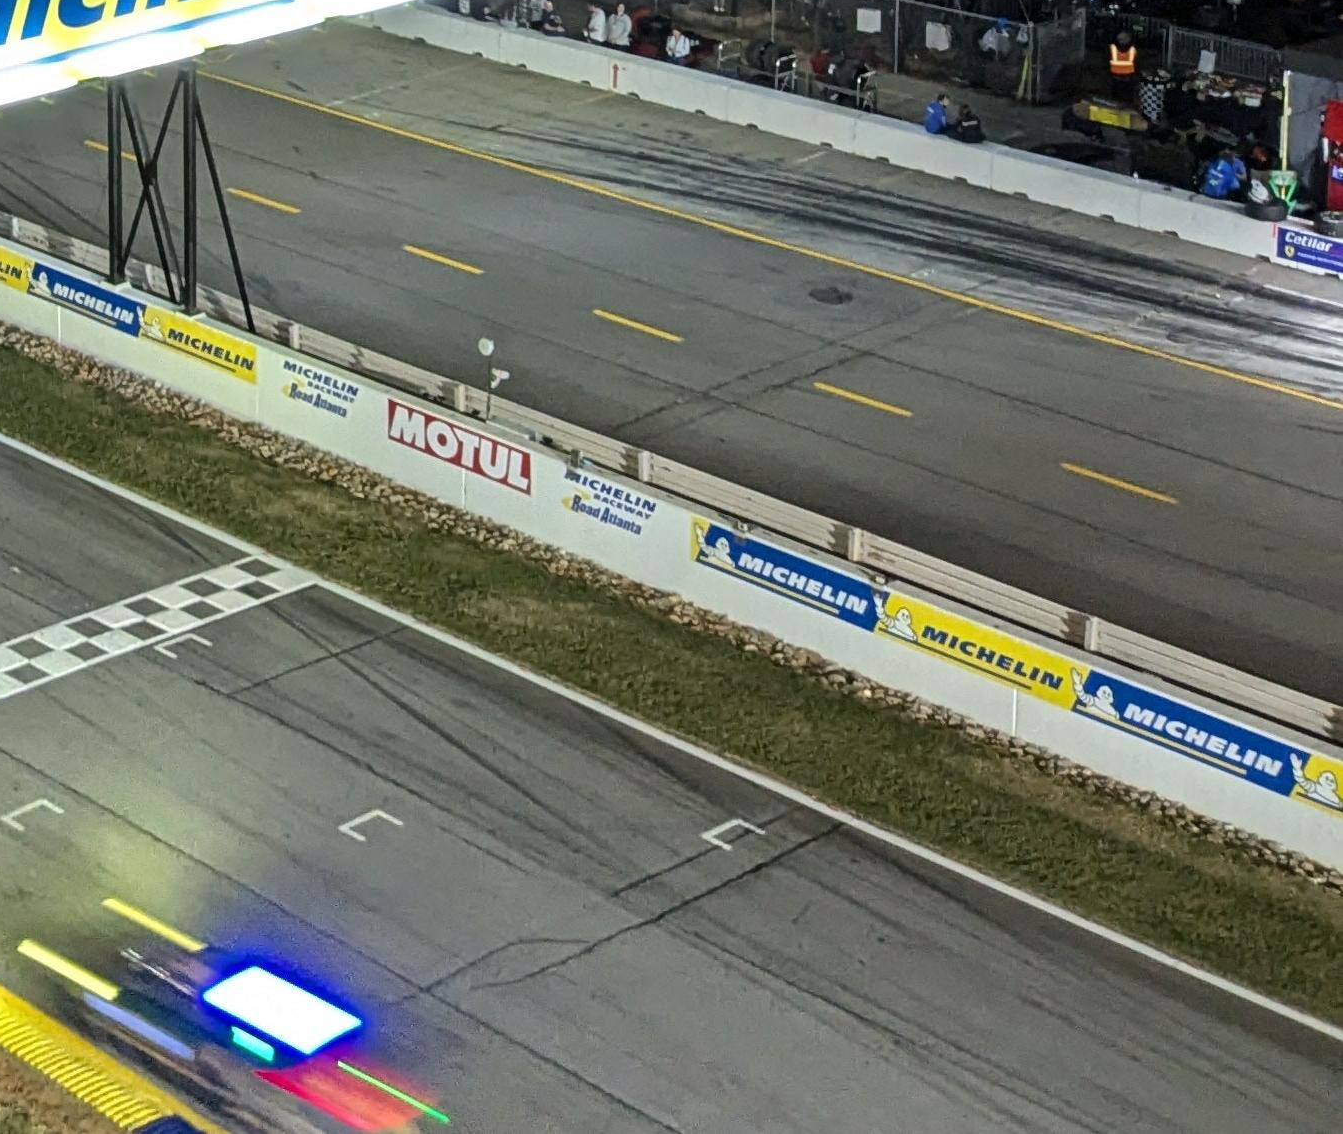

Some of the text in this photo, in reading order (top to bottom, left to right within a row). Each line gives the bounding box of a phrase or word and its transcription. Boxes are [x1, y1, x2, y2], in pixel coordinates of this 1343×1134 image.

[1285, 231, 1333, 253] Cetilar
[52, 281, 135, 325] MICHELIN
[167, 326, 255, 371] MICHELIN
[282, 358, 360, 398] MICHELIN
[290, 381, 348, 419] Road Atlanta
[306, 379, 356, 404] RACEWAY
[389, 403, 530, 491] MOTUL
[564, 468, 657, 513] MICHELIN
[592, 493, 653, 520] RACEWAY
[571, 494, 643, 536] Road Atlanta
[737, 552, 868, 616] MICHELIN
[921, 625, 1064, 691] MICHELIN
[1123, 702, 1284, 777] MICHELIN
